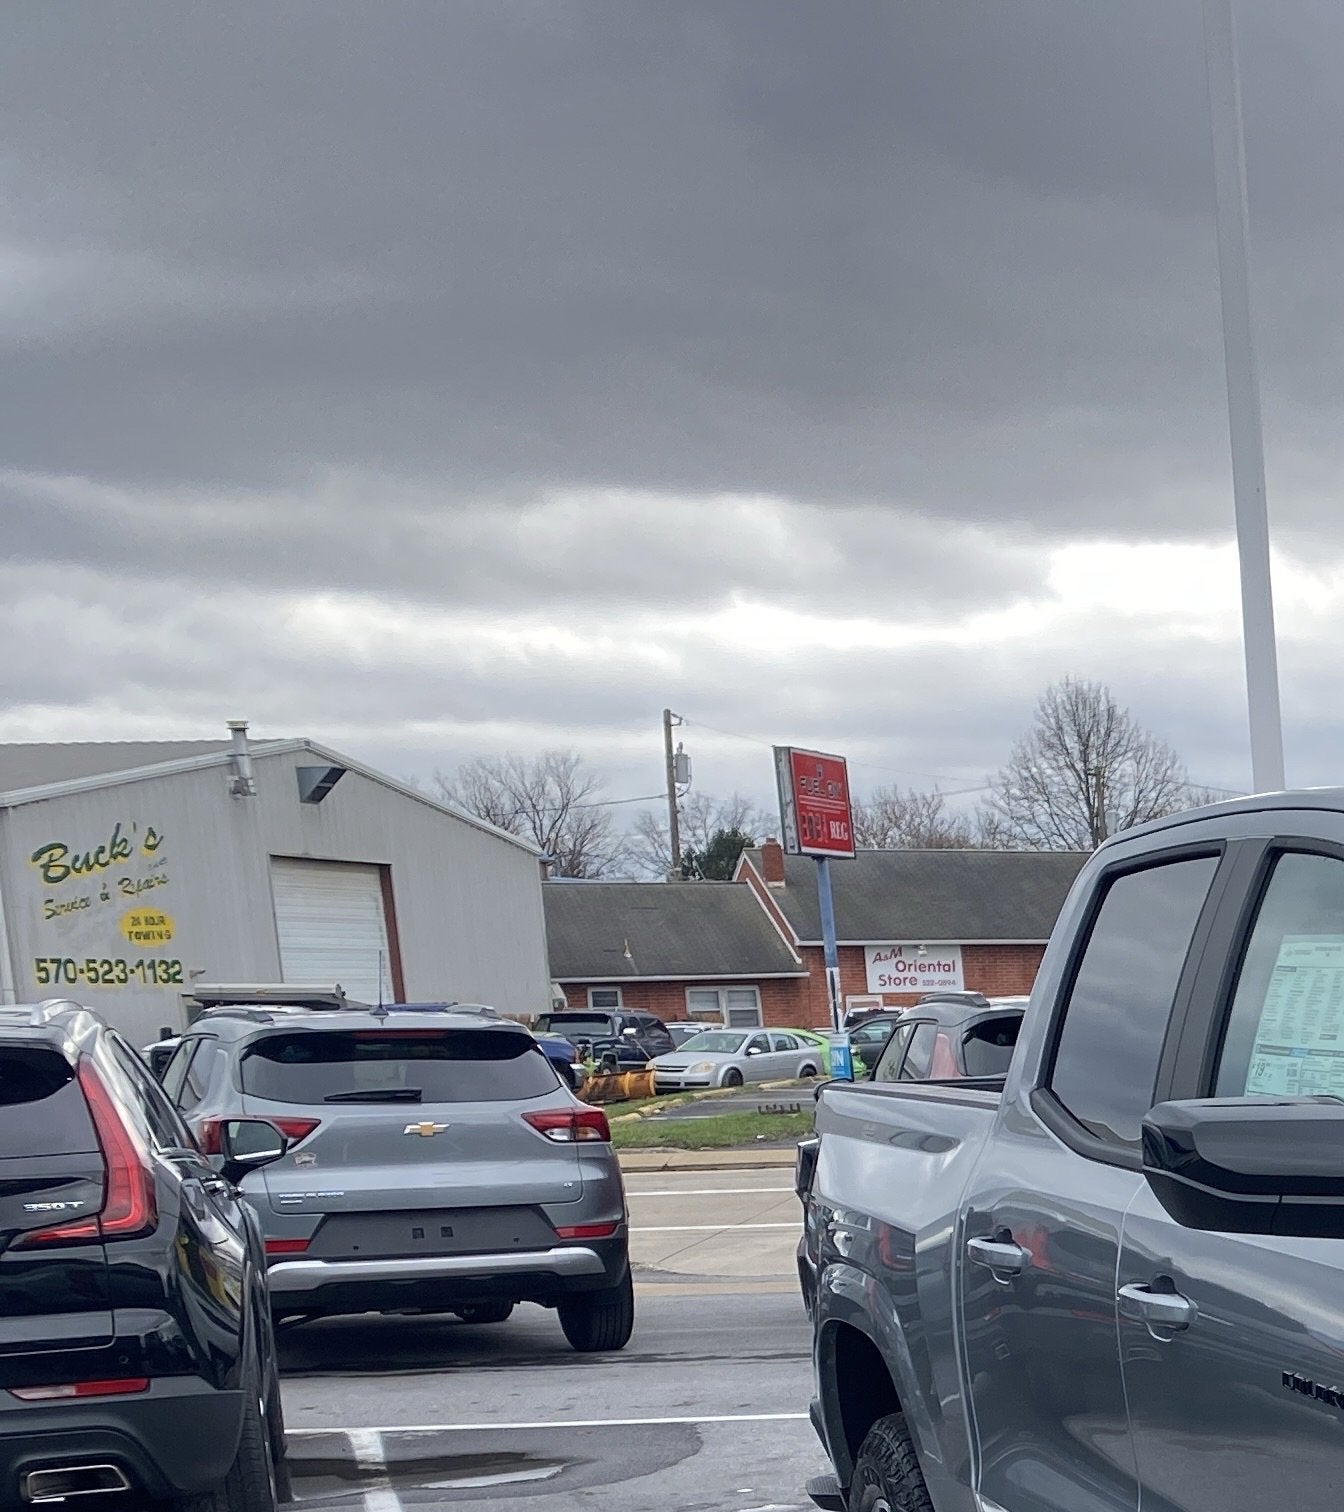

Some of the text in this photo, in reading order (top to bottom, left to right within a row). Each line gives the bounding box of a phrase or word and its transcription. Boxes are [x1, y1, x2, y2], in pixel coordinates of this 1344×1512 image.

[800, 775, 827, 796] FUEL
[829, 820, 848, 841] REG
[31, 821, 164, 884] Buck's
[44, 897, 92, 920] Service
[143, 915, 166, 926] HOUR
[127, 929, 172, 941] TOWING
[895, 959, 956, 973] Oriental
[878, 973, 918, 987] Store
[23, 1200, 85, 1212] 350T
